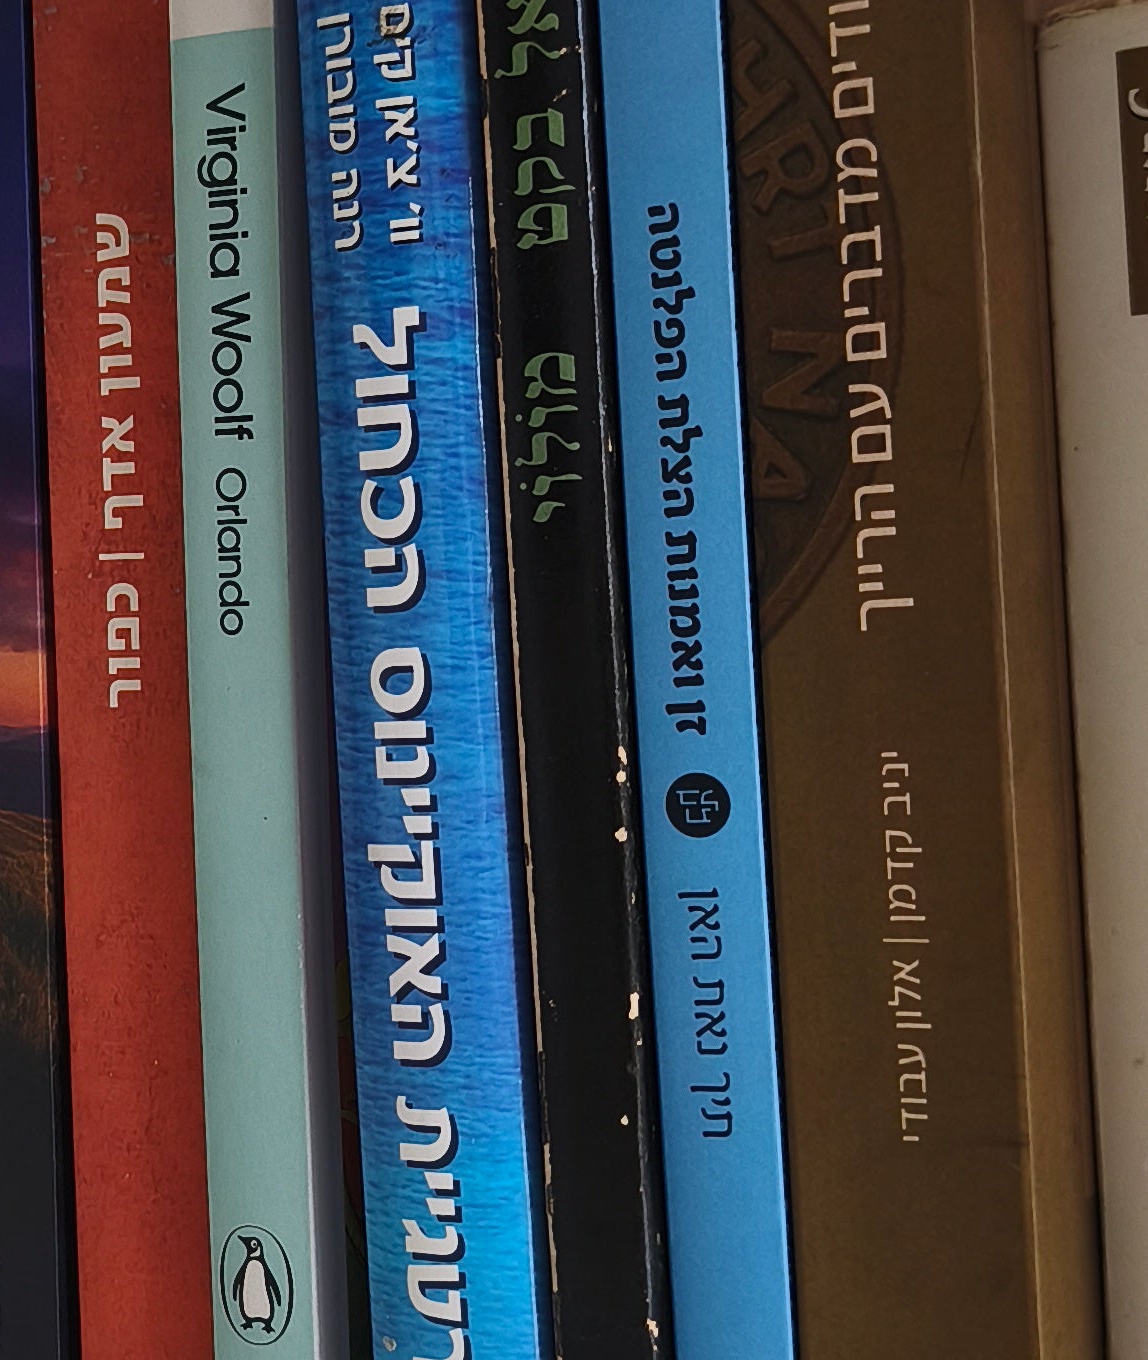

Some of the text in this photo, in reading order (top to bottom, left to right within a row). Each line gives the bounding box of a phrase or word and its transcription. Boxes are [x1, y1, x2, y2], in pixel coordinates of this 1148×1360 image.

[315, 11, 362, 251] רנה מובורן
[372, 1, 414, 80] קים
[513, 106, 569, 249] בקט
[834, 137, 888, 363] מדברים
[94, 211, 145, 710] שמעון אדף כפור
[195, 81, 255, 637] Virginia Woolf Orlando
[351, 304, 421, 609] הכחול
[646, 201, 708, 737] זן ואמנות הצלת הפלנטה
[847, 382, 894, 465] עם
[853, 482, 915, 633] הרייך
[366, 645, 447, 1062] האוקיינוס
[880, 750, 933, 1143] יניב קדמן אלון עבודי
[676, 886, 735, 1139] תיך נאת האן
